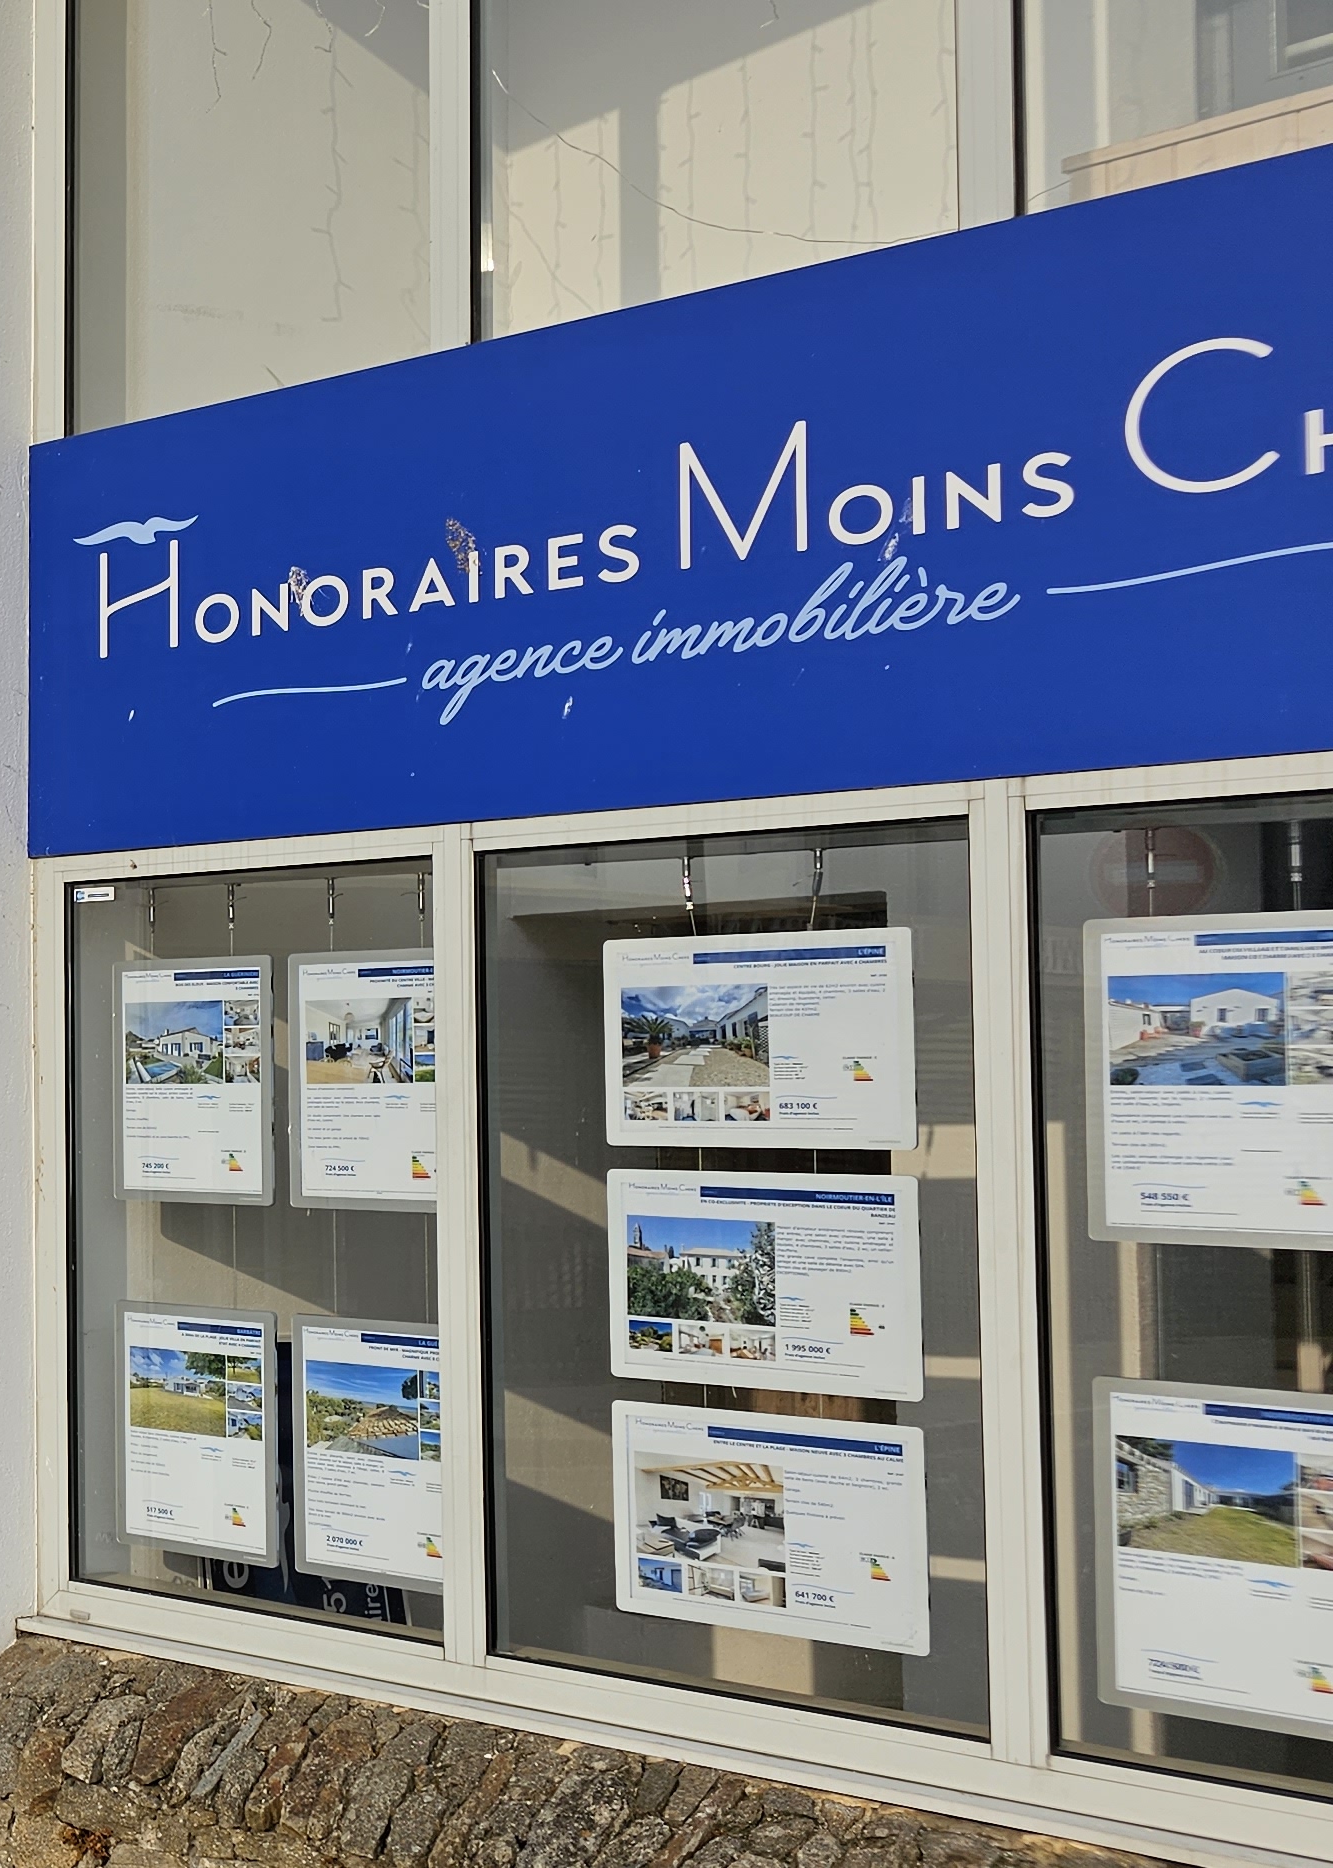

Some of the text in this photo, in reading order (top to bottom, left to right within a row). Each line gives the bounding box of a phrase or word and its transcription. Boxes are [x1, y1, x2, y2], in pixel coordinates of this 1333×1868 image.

[98, 523, 641, 660] HONORAIRES
[678, 420, 1075, 570] MOINS
[422, 556, 1022, 727] agence immobilière
[792, 1344, 806, 1352] 995
[874, 1445, 901, 1454] L'ÉPINE
[812, 1592, 827, 1601] 700
